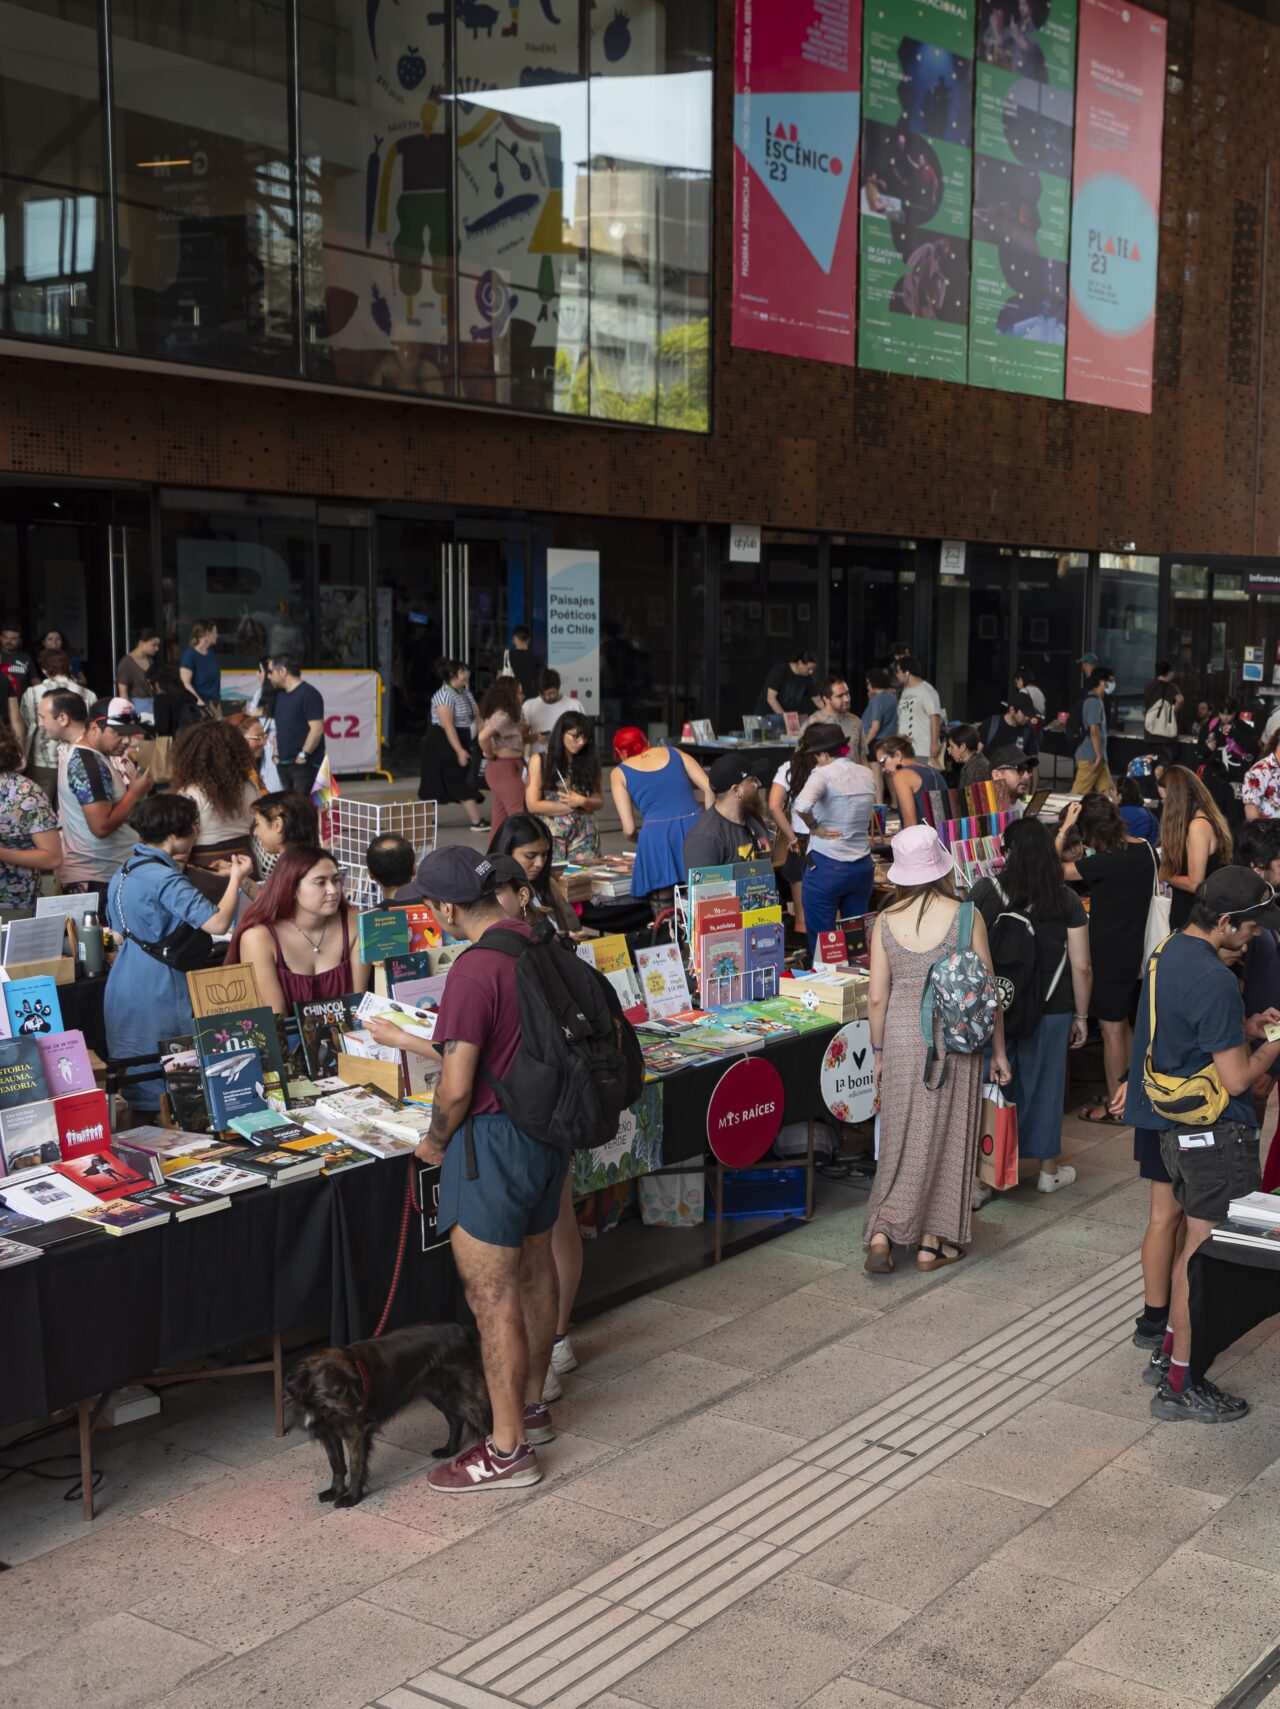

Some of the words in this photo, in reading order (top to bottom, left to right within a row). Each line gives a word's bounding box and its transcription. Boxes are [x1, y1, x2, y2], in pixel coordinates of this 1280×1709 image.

[766, 116, 798, 143] LAB
[1088, 229, 1141, 262] PLATEA
[550, 594, 594, 607] Paisajes
[550, 609, 597, 620] Poéticos
[550, 624, 564, 634] de
[567, 624, 594, 634] Chile
[717, 922, 736, 930] activista
[303, 1001, 346, 1017] CHINCOL
[323, 1012, 345, 1025] JOTE
[742, 1101, 775, 1122] RAÍCES
